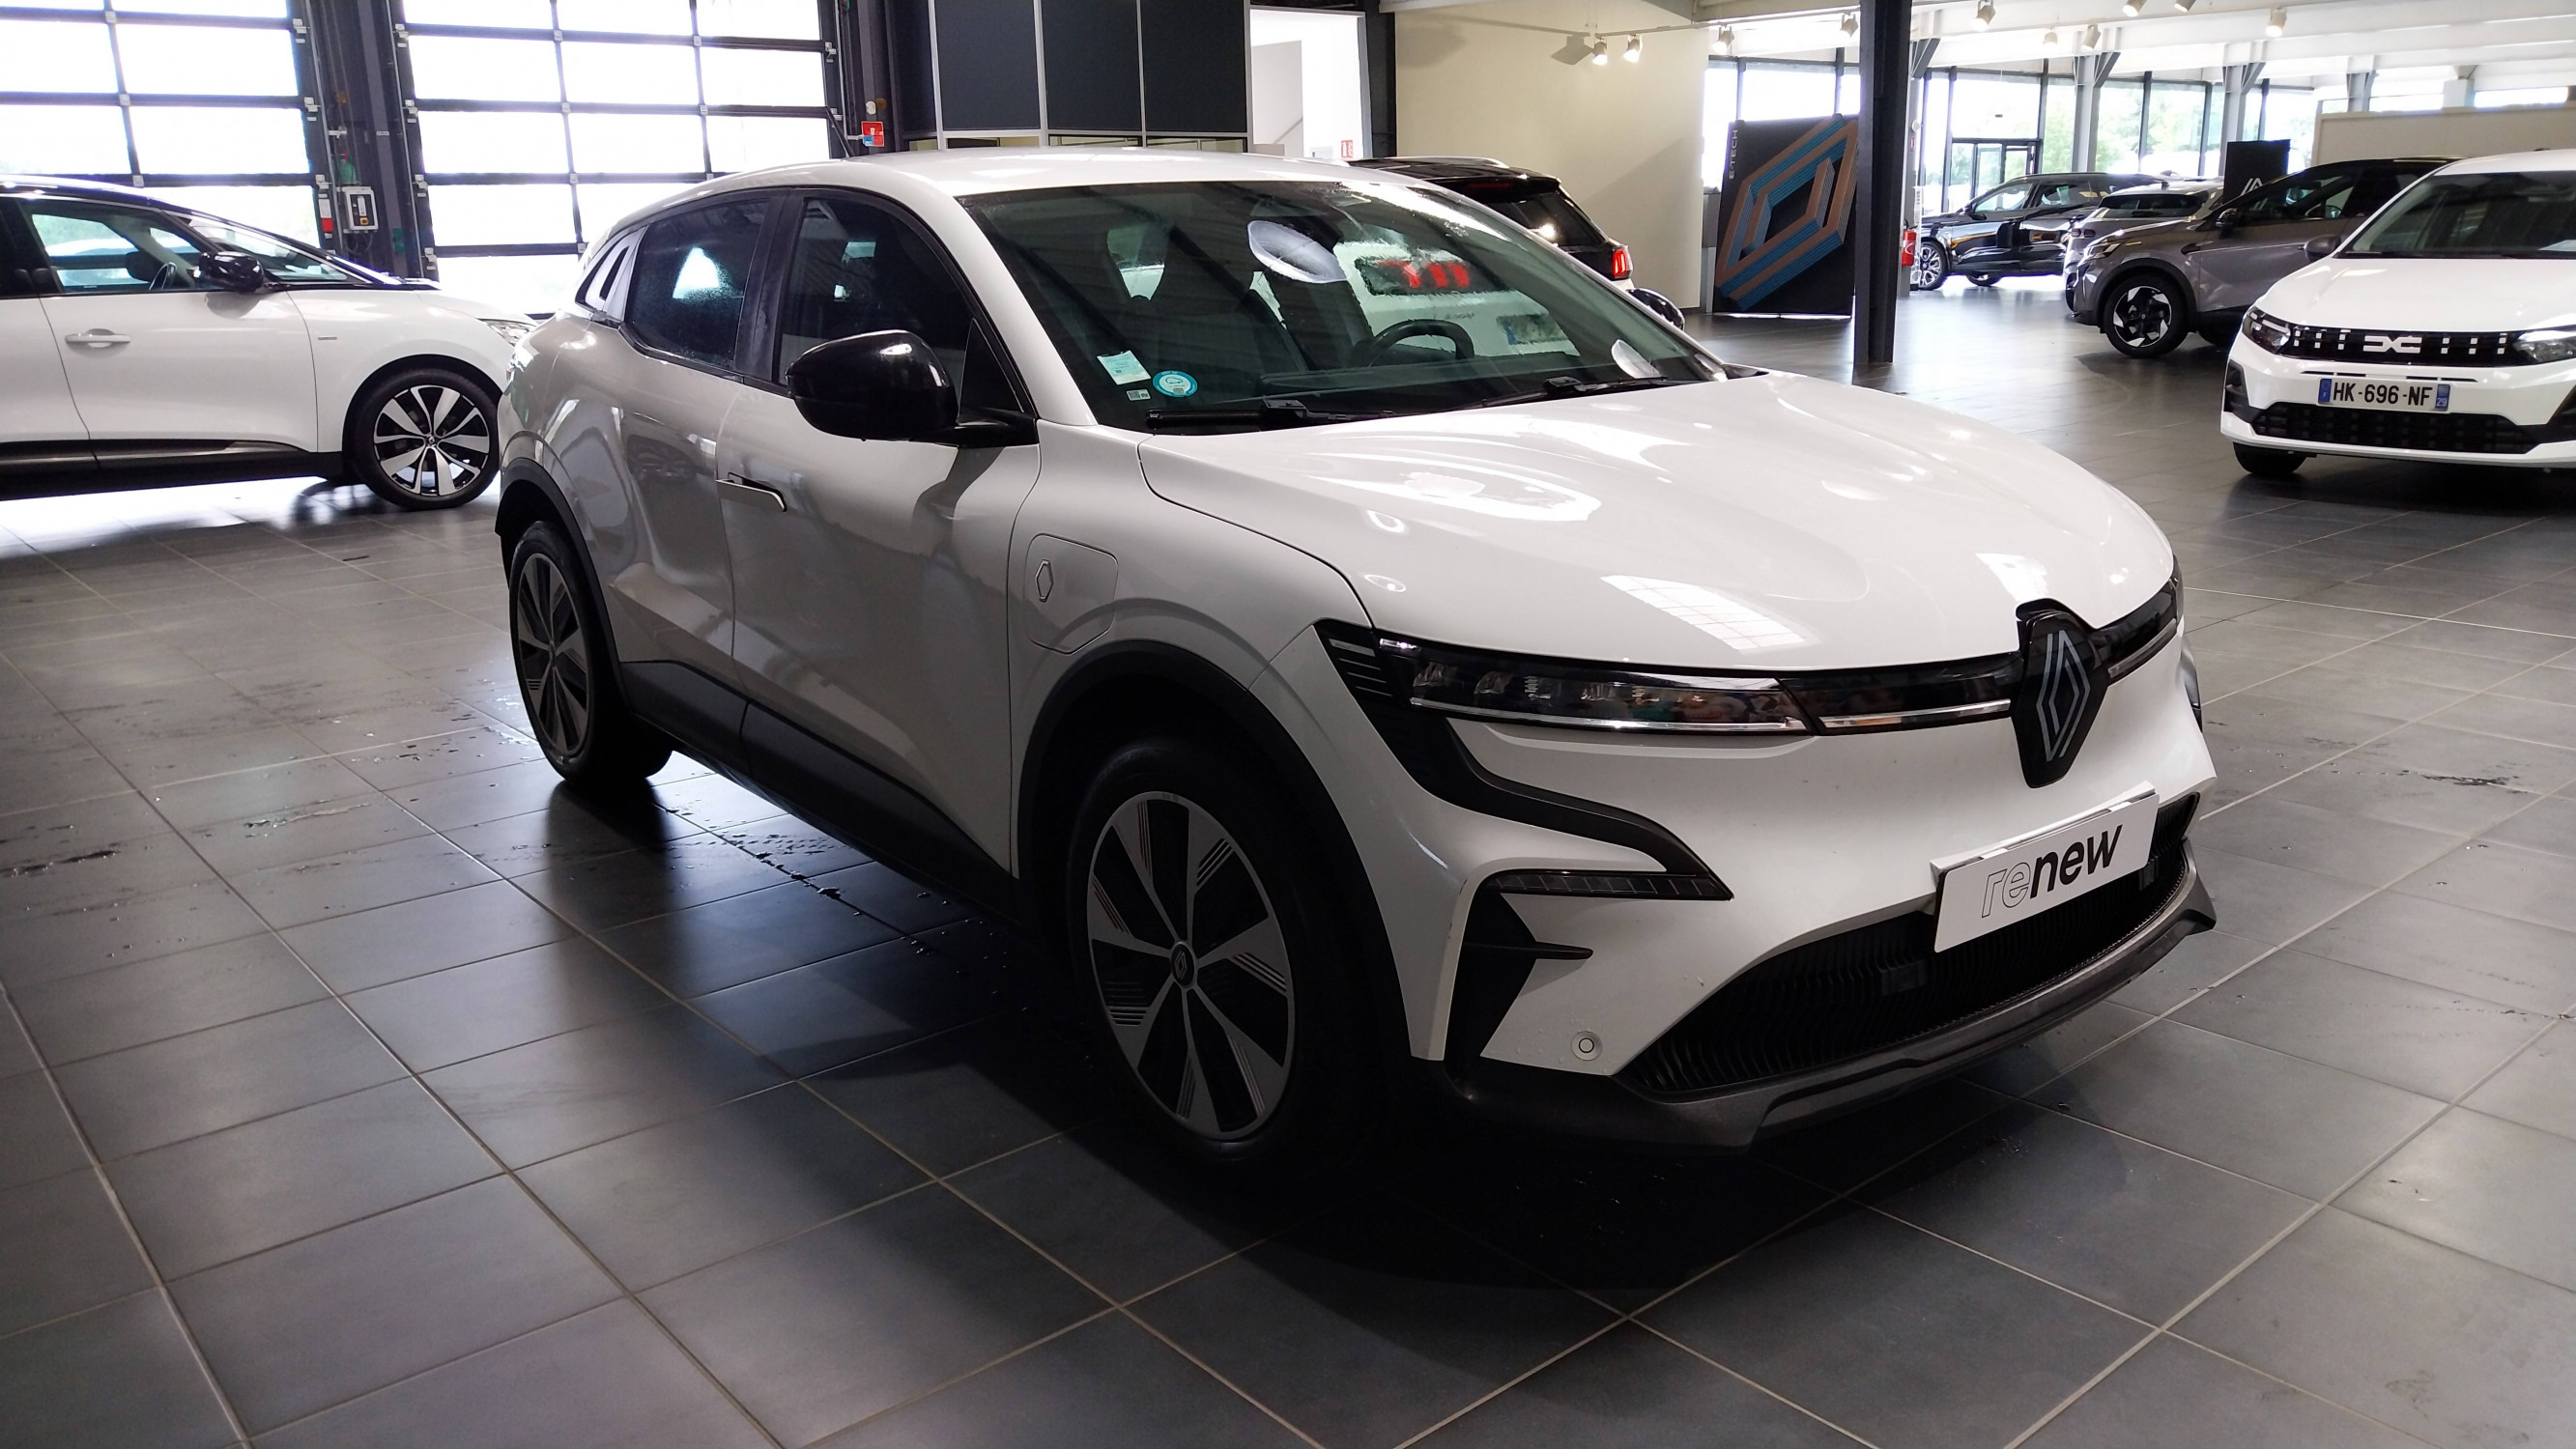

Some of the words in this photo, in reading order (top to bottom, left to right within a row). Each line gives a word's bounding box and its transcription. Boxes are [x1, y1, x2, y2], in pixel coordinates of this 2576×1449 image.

[1729, 129, 1738, 180] E-TECH
[2436, 397, 2447, 407] 29
[1982, 823, 2124, 919] renew
